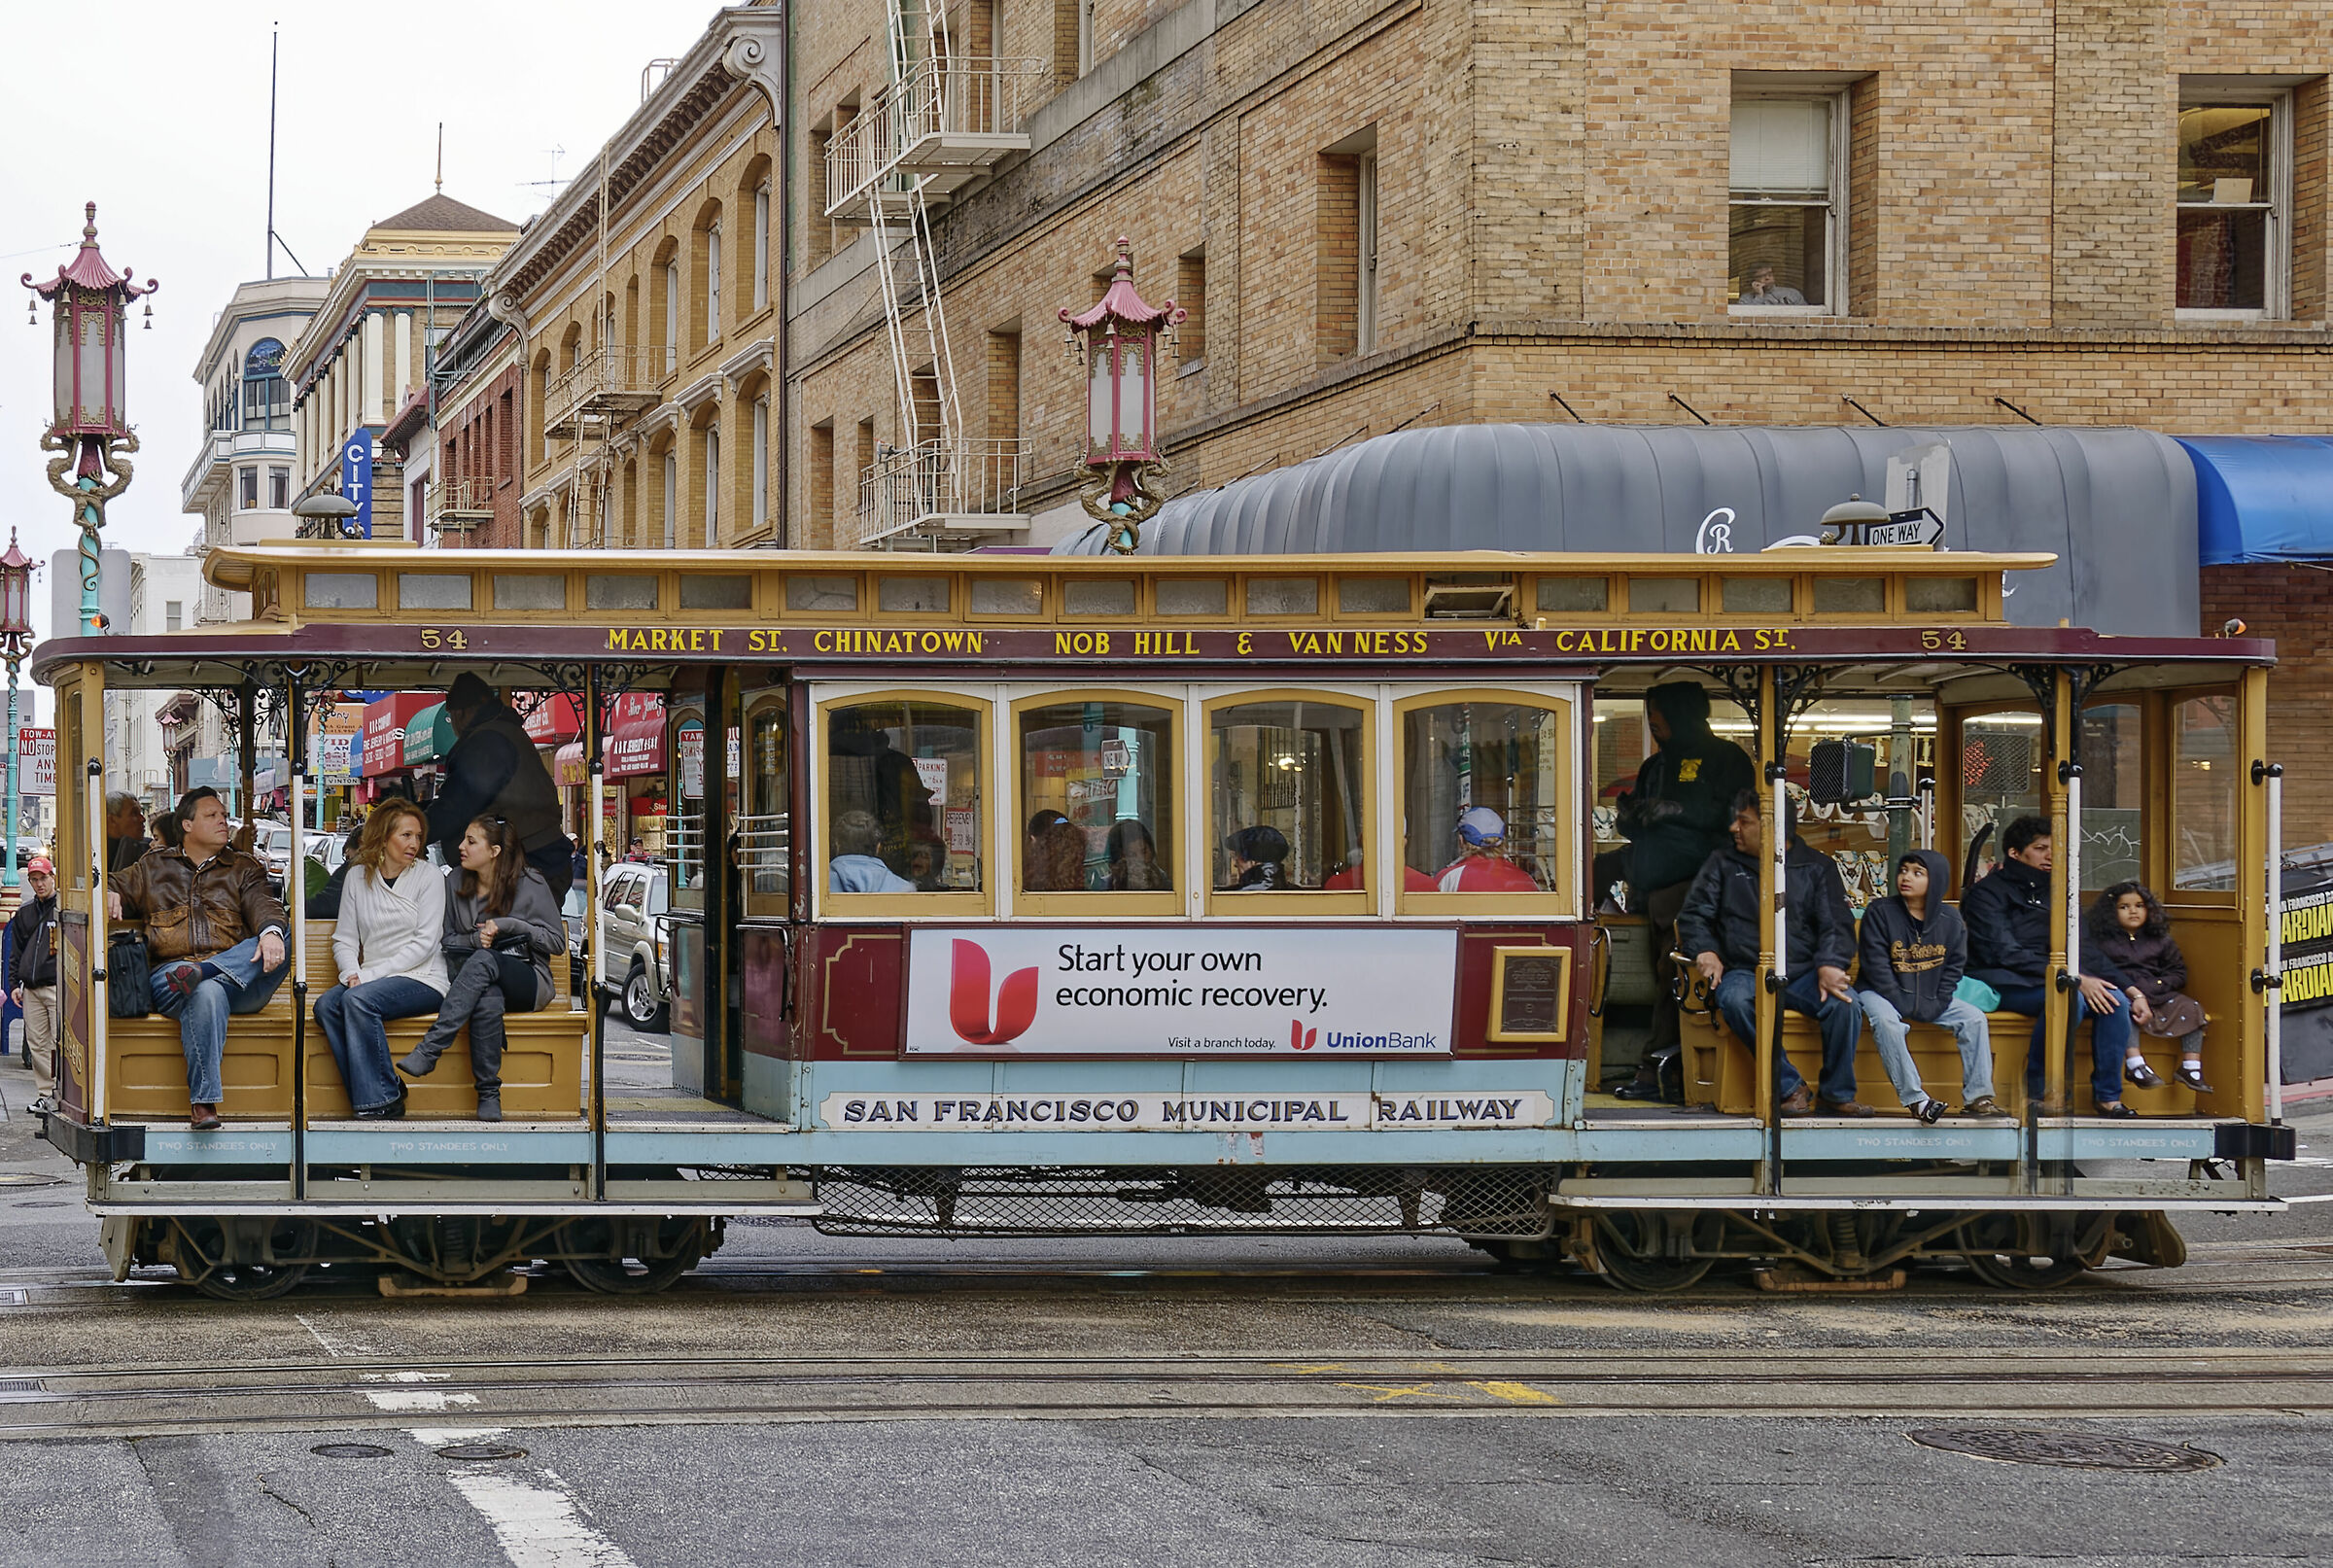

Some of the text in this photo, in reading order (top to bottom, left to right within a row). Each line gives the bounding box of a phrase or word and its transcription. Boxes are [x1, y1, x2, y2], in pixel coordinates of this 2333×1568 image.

[1872, 522, 1922, 545] ONE WAY
[421, 629, 468, 650] 54
[609, 629, 723, 651] MARKET
[748, 630, 788, 652] ST.
[814, 630, 982, 653] CHINATOWN
[1055, 632, 1110, 654] NOB
[1134, 633, 1201, 655] HILL
[1236, 633, 1253, 654] &
[1288, 632, 1343, 654] VAN
[1354, 632, 1428, 654] NESS
[1556, 630, 1742, 652] CALIFORNIA
[1754, 629, 1795, 651] ST.
[1921, 630, 1967, 650] 54
[20, 740, 35, 755] NO
[919, 763, 945, 772] PARKING
[2287, 892, 2326, 912] FRANCISCO
[1058, 944, 1262, 979] Start your own
[1056, 978, 1328, 1014] economic recovery.
[1168, 1036, 1191, 1048] Visit
[1204, 1036, 1242, 1048] branch
[1244, 1037, 1275, 1050] today.
[1326, 1031, 1437, 1049] UnionBank
[844, 1099, 1522, 1124] SAN FRANCISCO MUNICIPAL RAILWAY
[157, 1141, 277, 1151] TWO STANDEES ONLY
[389, 1141, 508, 1151] TWO STANDEES ONLY
[1857, 1137, 1972, 1146] TWO STANDEES ONLY
